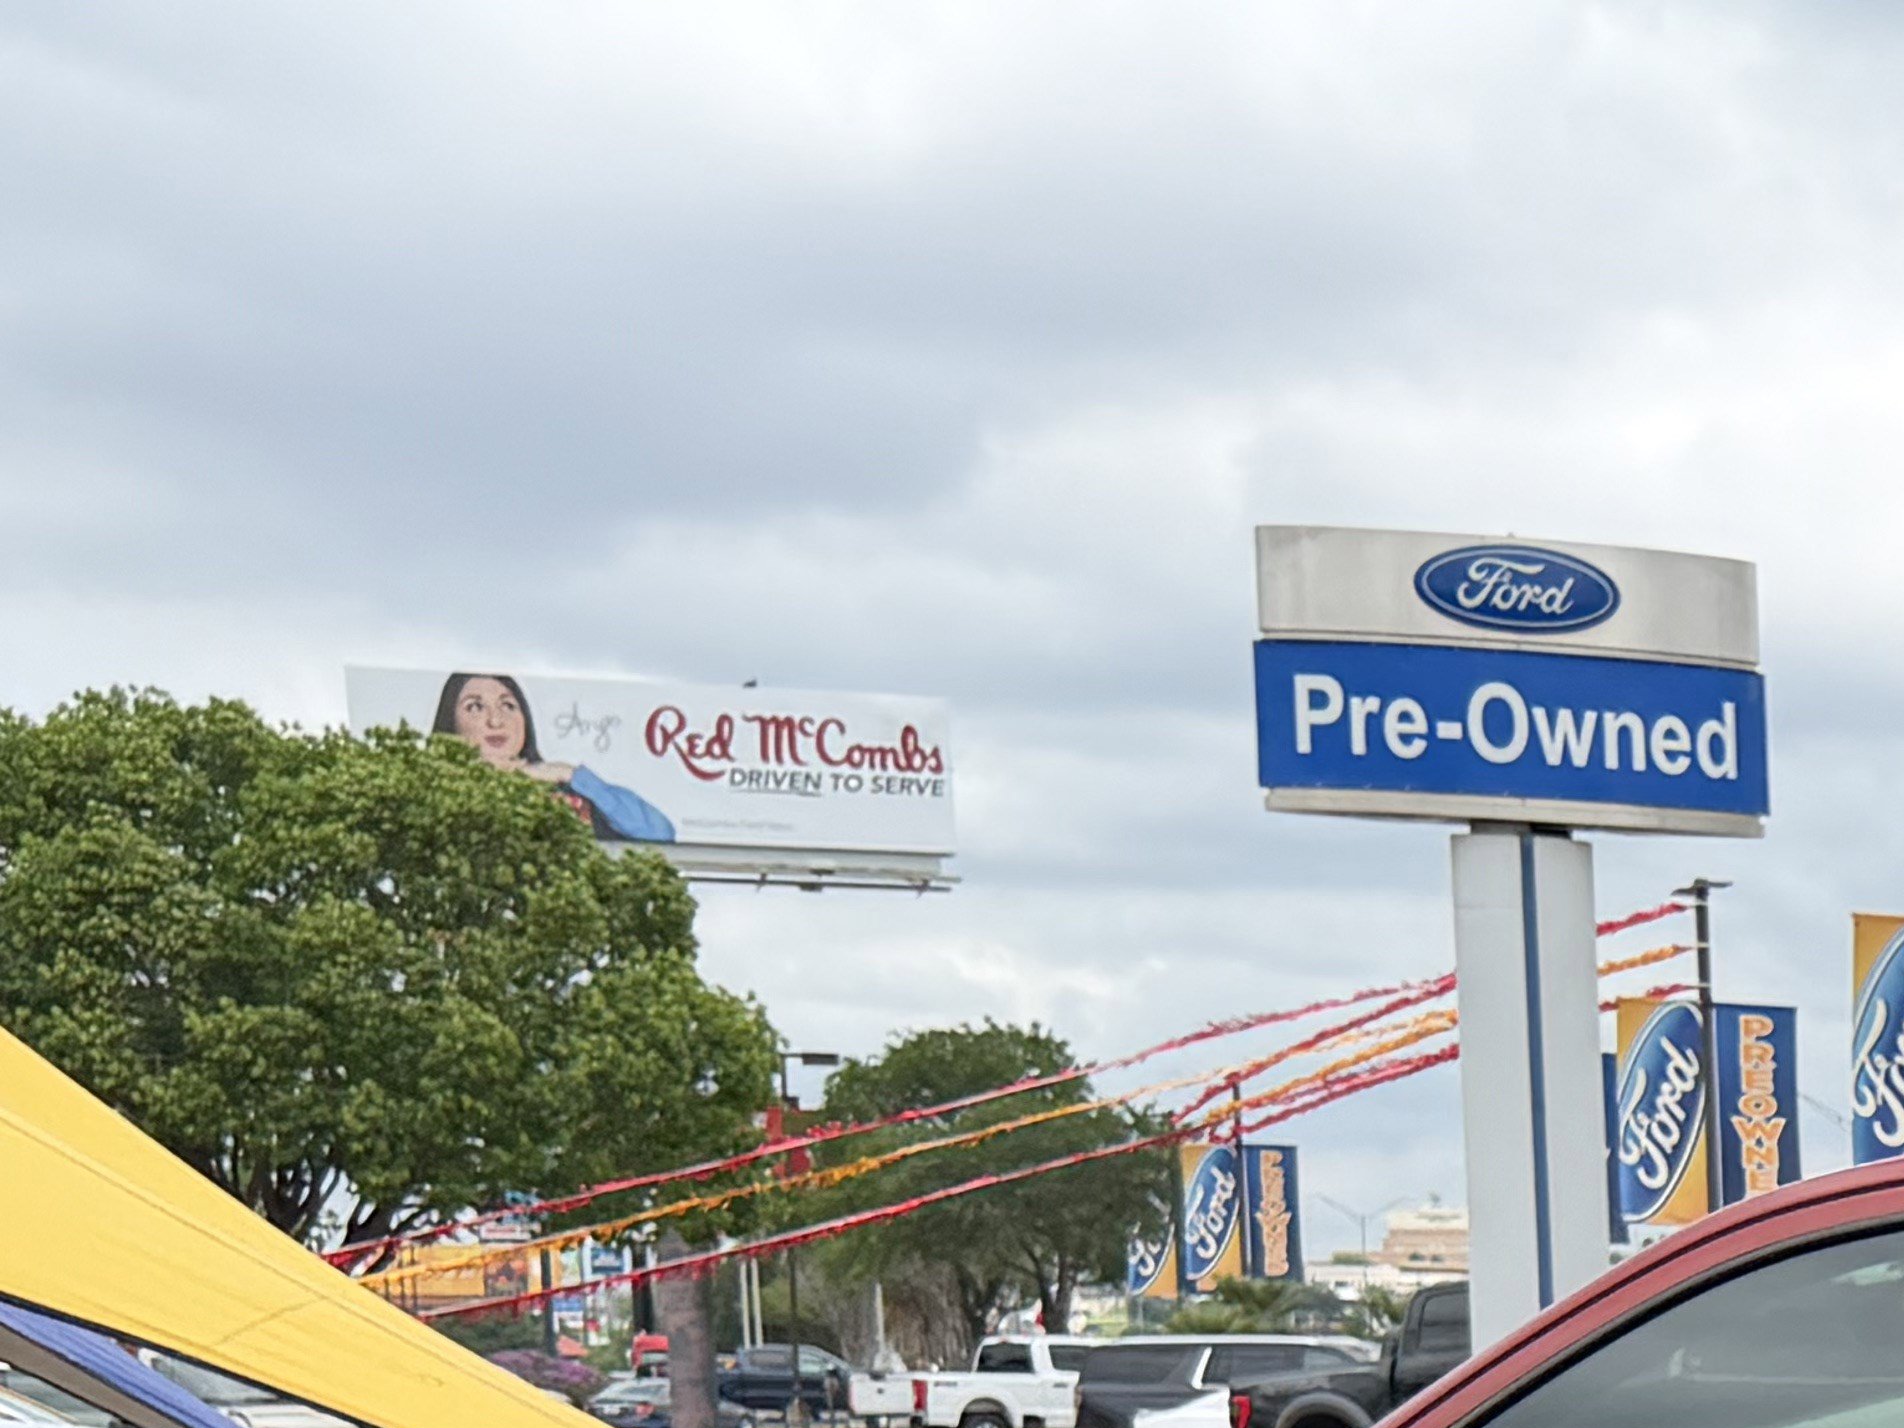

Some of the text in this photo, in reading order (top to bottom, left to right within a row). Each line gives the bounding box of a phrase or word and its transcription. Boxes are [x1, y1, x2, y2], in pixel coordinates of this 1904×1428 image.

[1457, 557, 1574, 616] Ford
[645, 704, 945, 782] Red McCombs
[1293, 673, 1737, 780] Pre-Owned
[729, 767, 945, 798] DRIVEN TO SERVE
[1619, 1035, 1700, 1190] Ford
[1730, 1013, 1787, 1194] PREOWNE
[1185, 1165, 1236, 1260] Ford
